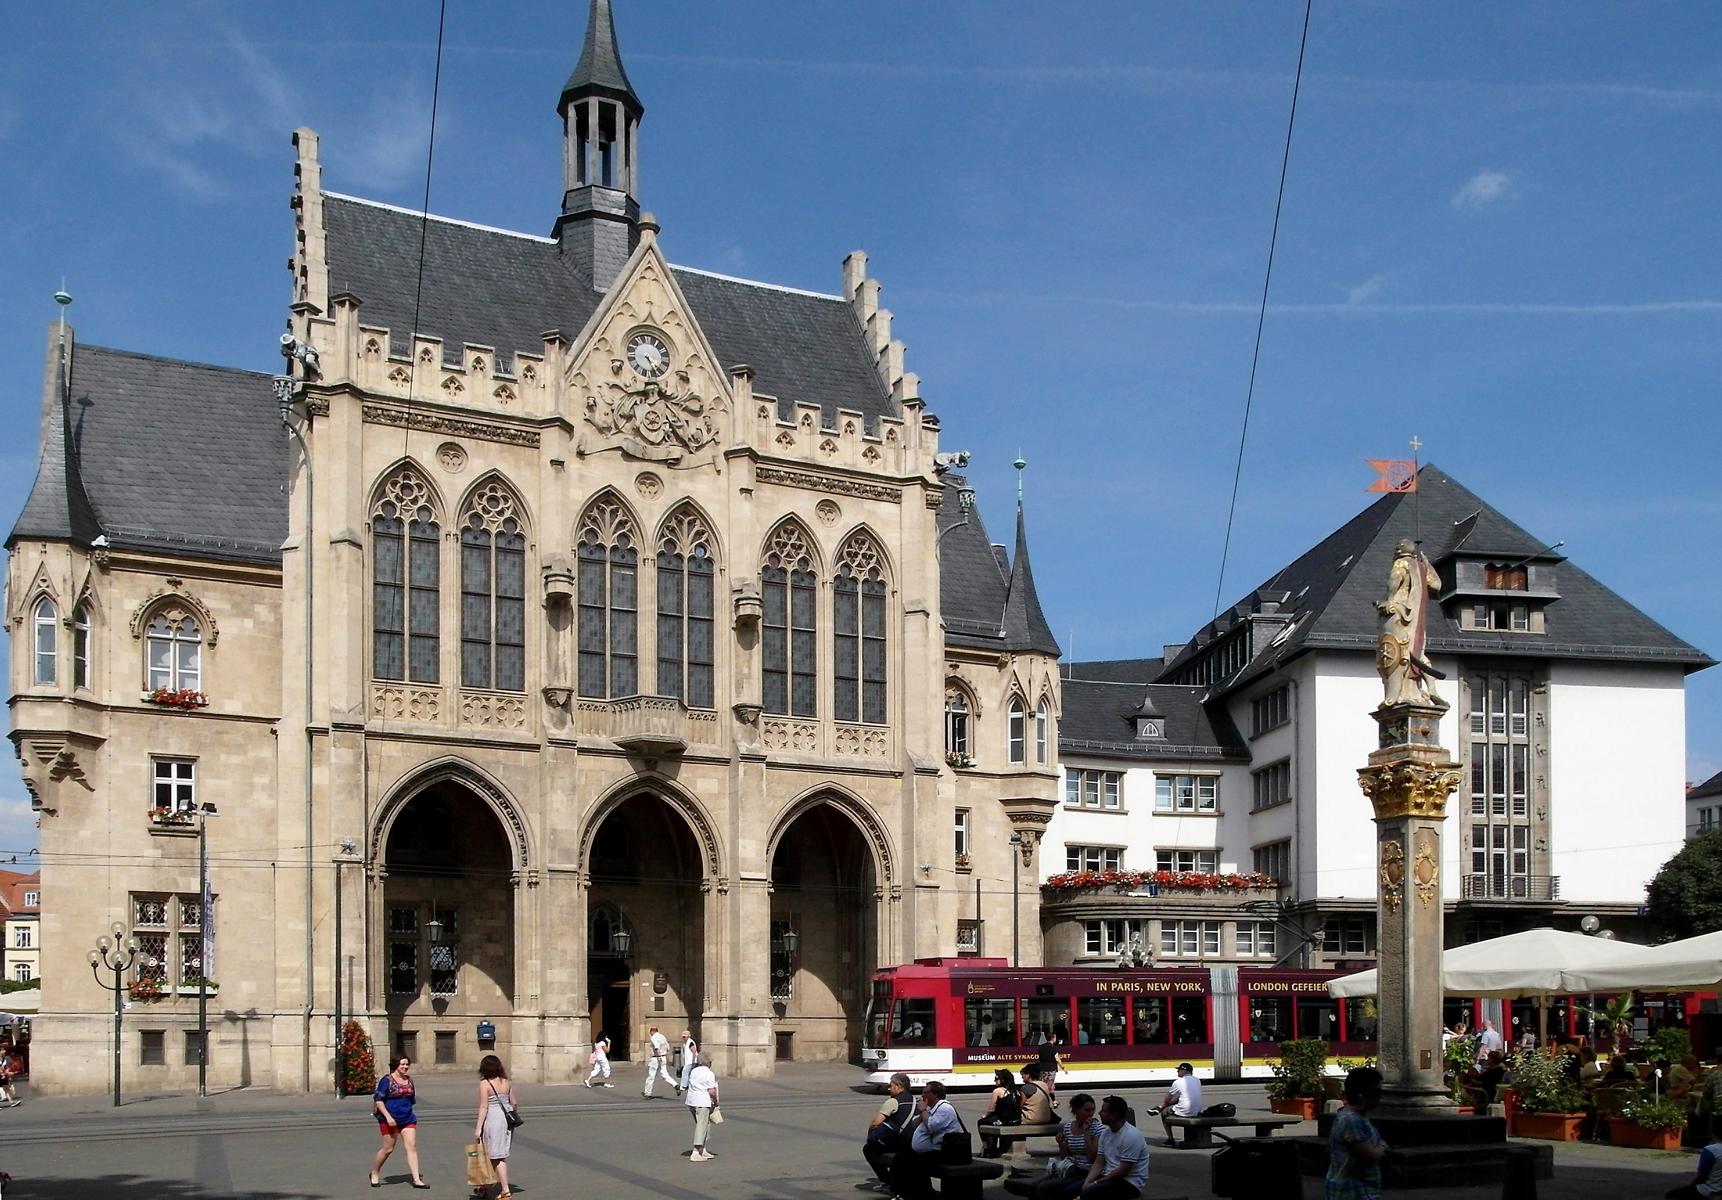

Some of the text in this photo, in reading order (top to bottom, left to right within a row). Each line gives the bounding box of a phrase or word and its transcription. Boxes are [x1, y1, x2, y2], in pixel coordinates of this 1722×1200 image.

[1096, 982, 1205, 993] IN PARIS, NEW YORK,
[1248, 982, 1328, 992] LONDON GEFEIER
